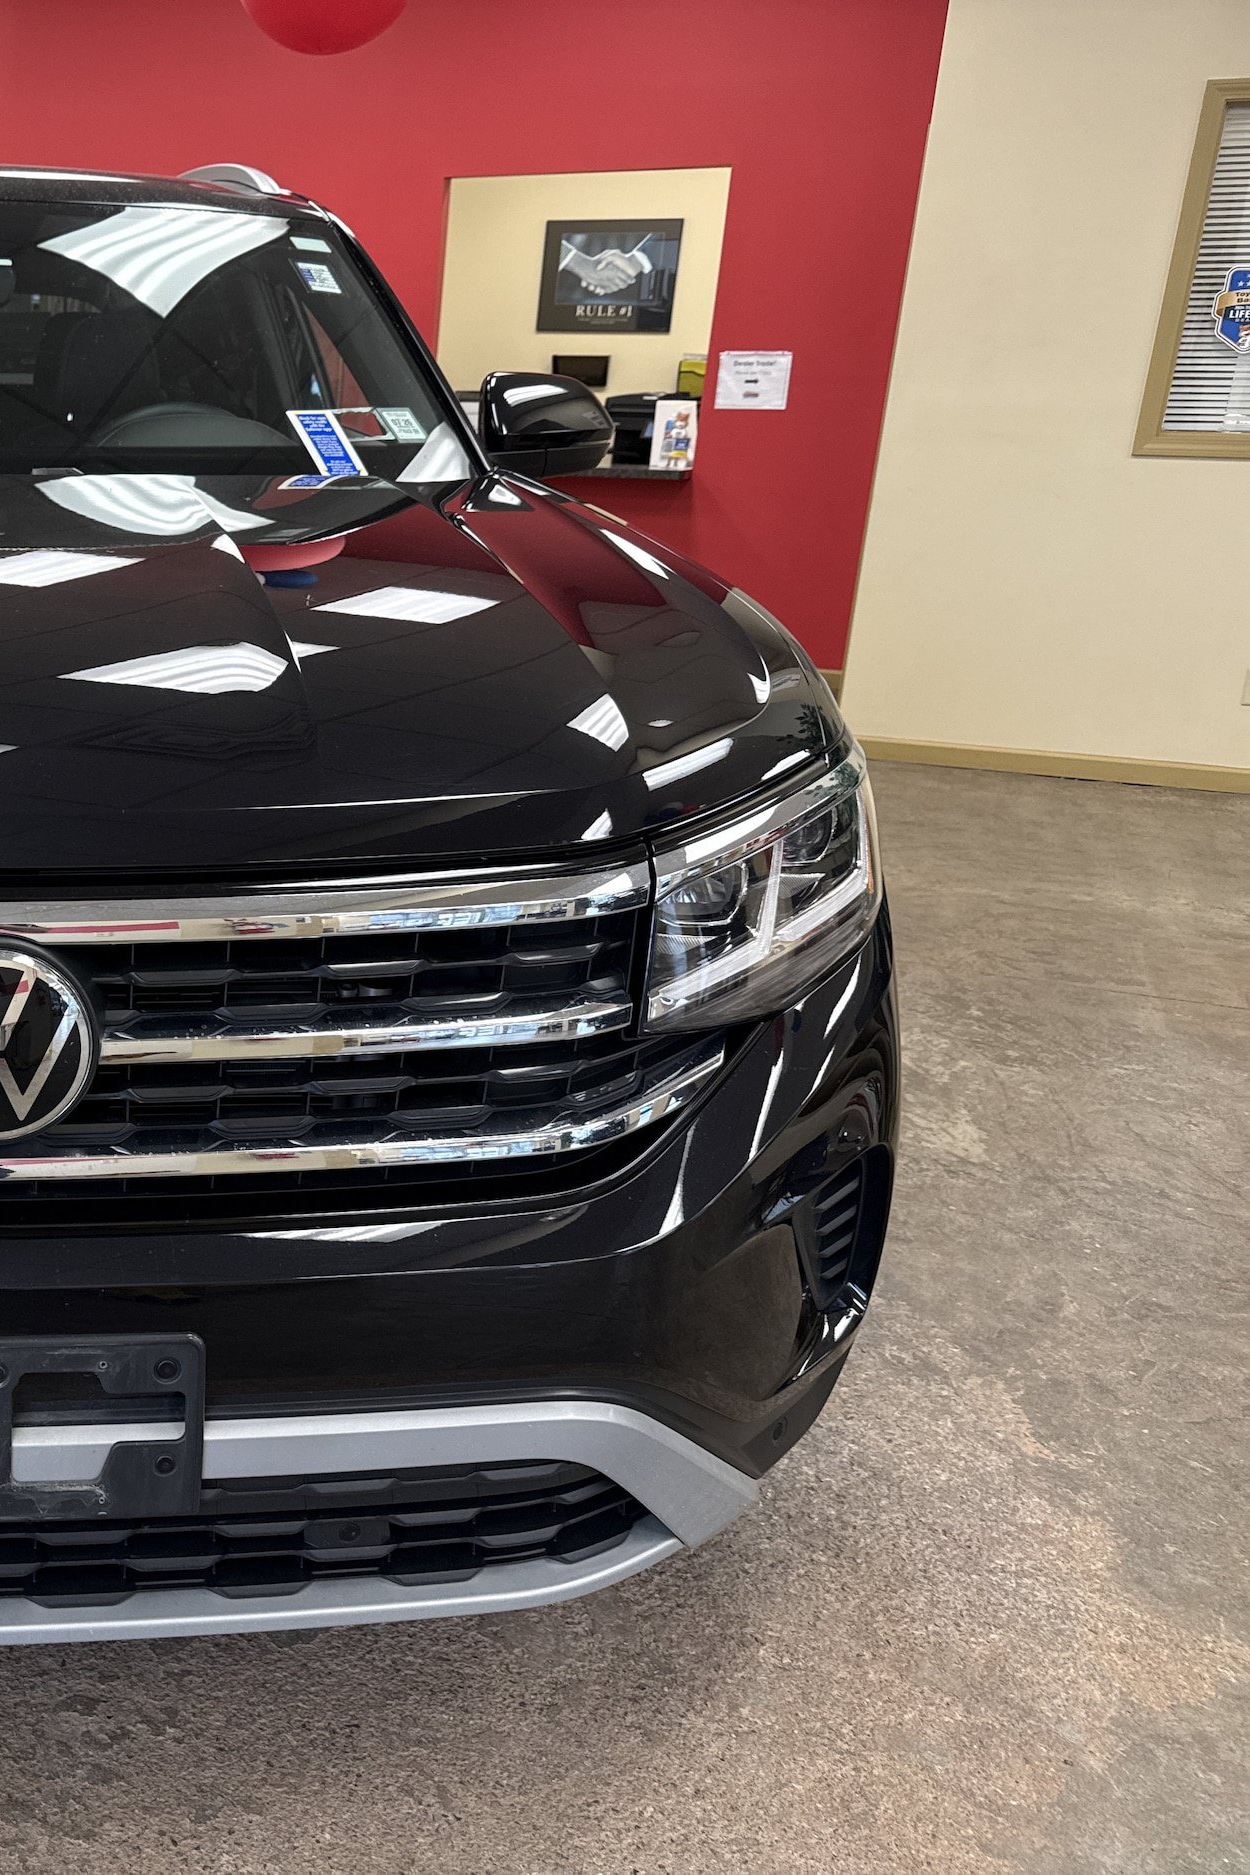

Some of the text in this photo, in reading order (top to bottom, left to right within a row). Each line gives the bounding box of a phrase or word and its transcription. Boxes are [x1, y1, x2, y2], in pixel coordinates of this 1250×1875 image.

[575, 304, 633, 317] RULE #1
[1229, 309, 1250, 318] LIFE
